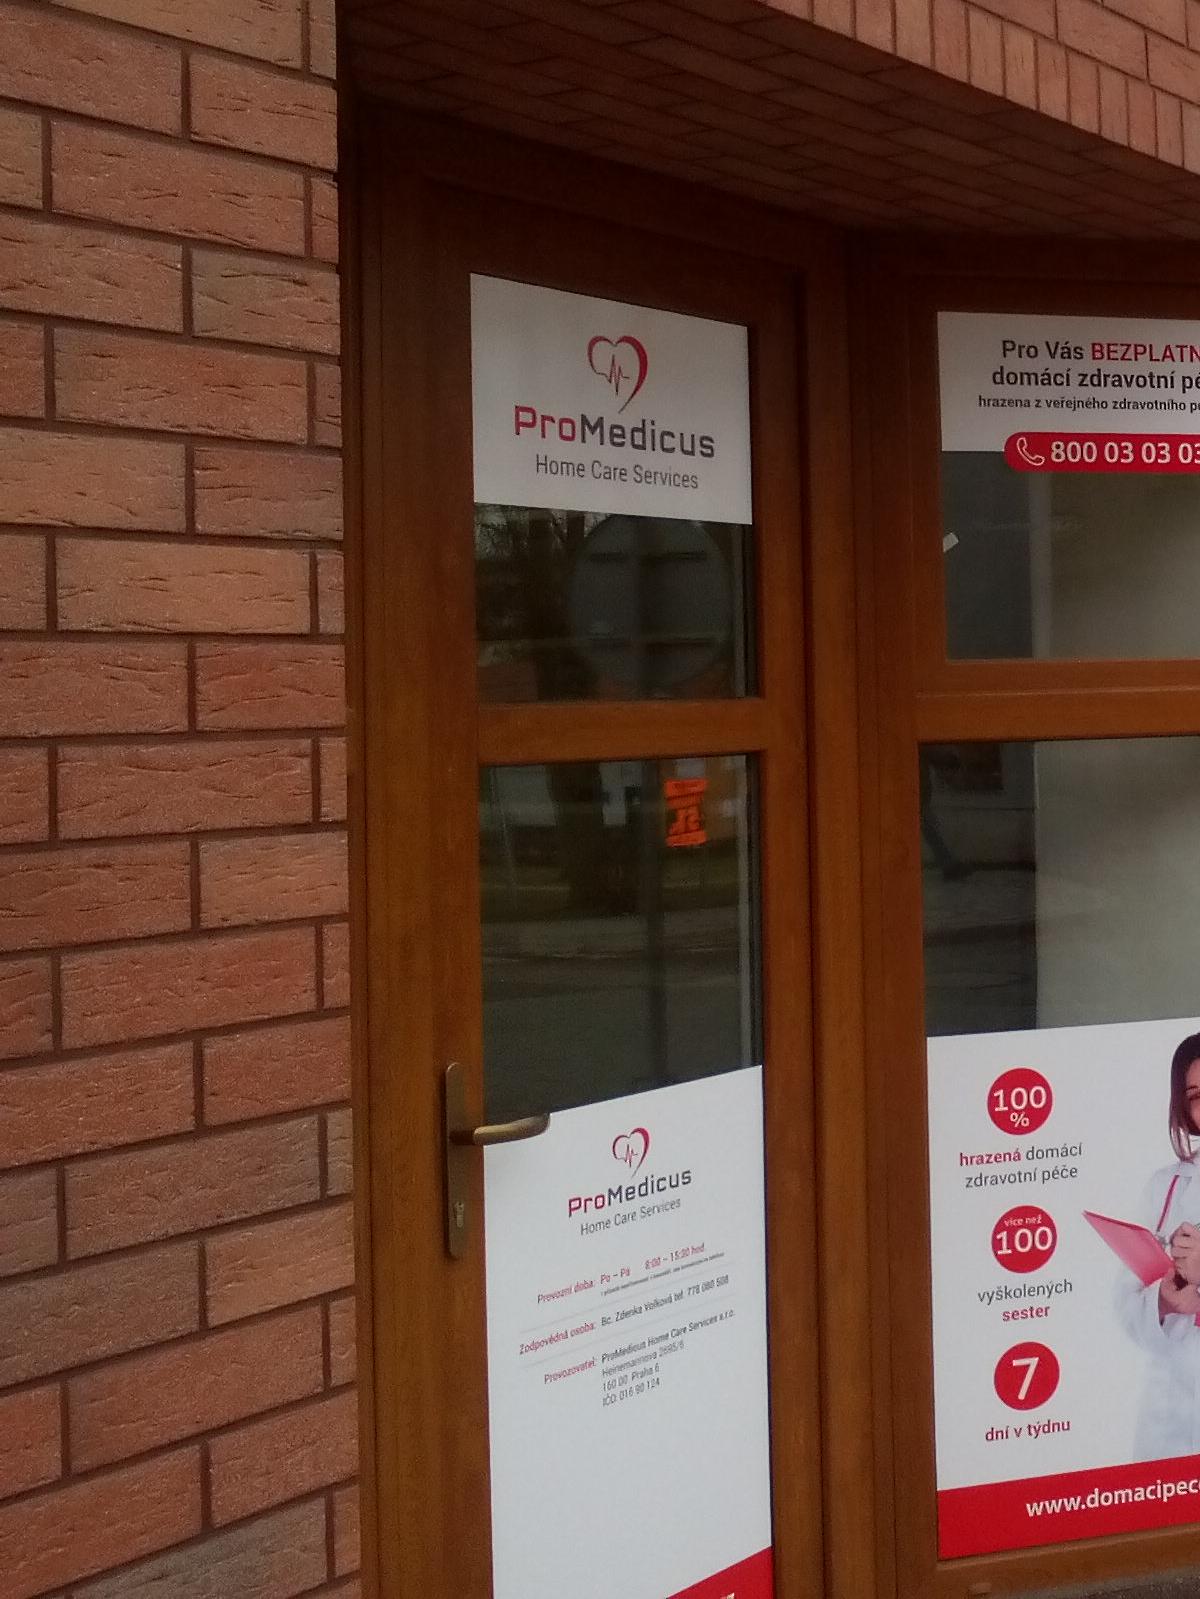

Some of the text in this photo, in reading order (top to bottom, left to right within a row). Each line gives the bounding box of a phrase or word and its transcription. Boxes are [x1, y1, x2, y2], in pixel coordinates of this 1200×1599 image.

[1002, 340, 1038, 359] Pro
[1045, 341, 1083, 361] Vás
[993, 367, 1072, 388] domácí
[1078, 369, 1175, 389] zdravotní
[978, 395, 1031, 408] hrazena
[1034, 398, 1042, 408] z
[1046, 396, 1108, 412] veřejného
[1112, 398, 1186, 412] zdravotního
[514, 405, 715, 458] ProMedicus
[1051, 441, 1097, 463] 800
[1104, 442, 1134, 464] 03
[1141, 442, 1171, 464] 03
[536, 453, 698, 489] Home Care Services
[993, 1085, 1047, 1112] 100
[1010, 1112, 1029, 1128] %
[960, 1142, 1082, 1166] hrazená domácí
[965, 1165, 1078, 1188] zdravotní péče
[568, 1169, 692, 1218] ProMedicus
[580, 1197, 681, 1236] Home Care Services
[1004, 1214, 1042, 1227] více než
[995, 1226, 1052, 1255] 100
[600, 1273, 611, 1284] Po
[978, 1279, 1072, 1305] vyškolených
[1002, 1305, 1050, 1322] sester
[601, 1341, 647, 1363] ProMedicus
[647, 1332, 669, 1347] Home
[670, 1326, 687, 1339] Care
[688, 1315, 718, 1332] Services
[631, 1366, 654, 1381] Praha
[1012, 1356, 1039, 1401] 7
[985, 1419, 1071, 1442] dní v týdnu
